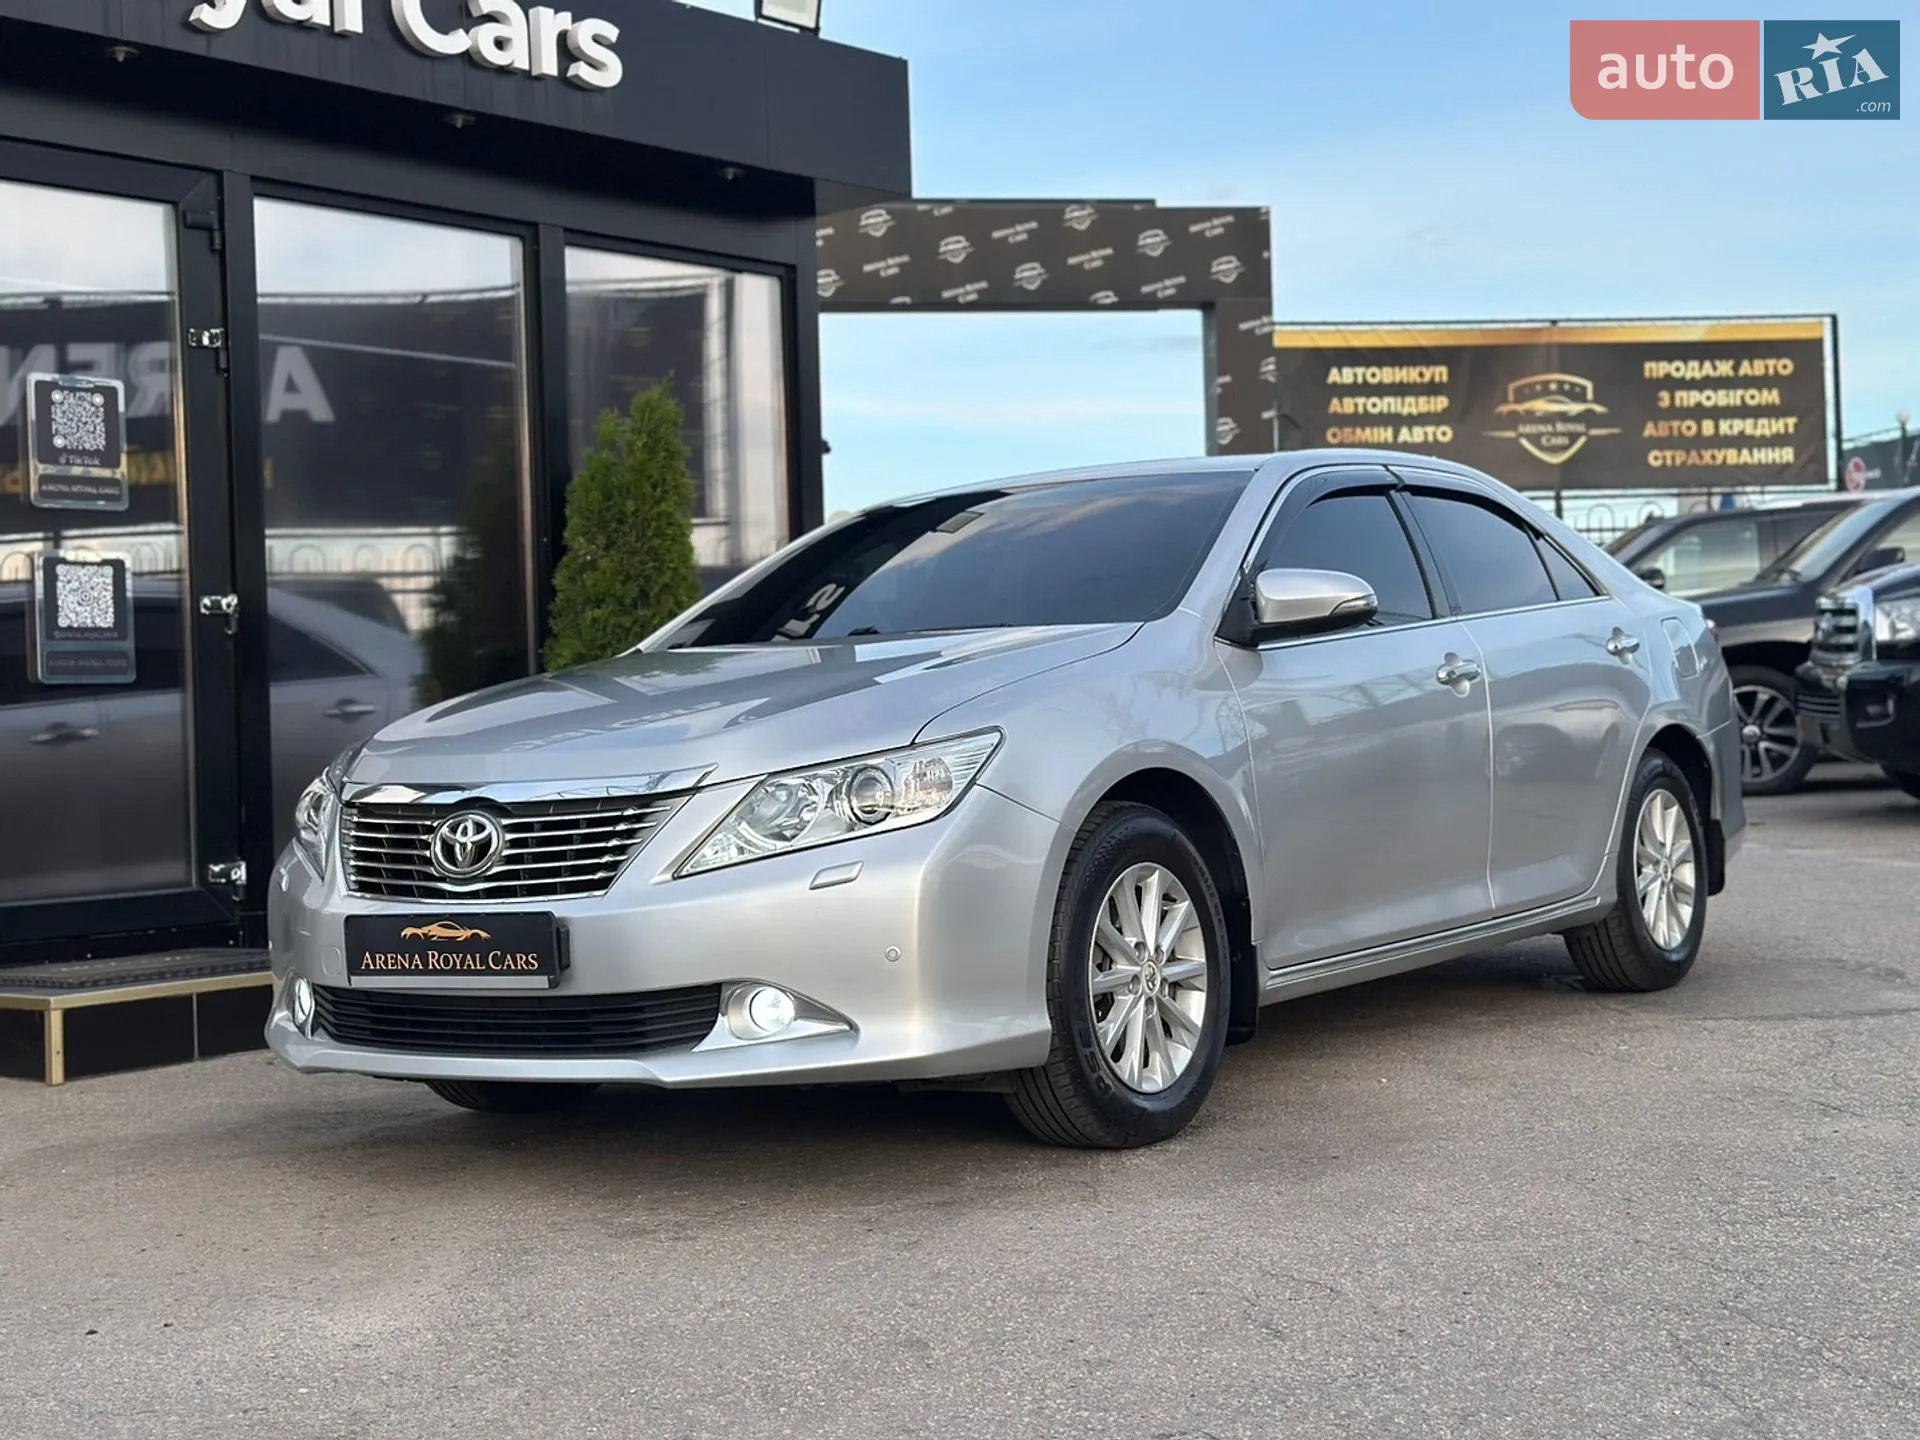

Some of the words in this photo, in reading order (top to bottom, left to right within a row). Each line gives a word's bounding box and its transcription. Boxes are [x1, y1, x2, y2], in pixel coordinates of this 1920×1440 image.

[1326, 365, 1449, 385] АВТОВИКУП
[1643, 359, 1735, 380] ПРОДАЖ
[1738, 358, 1795, 376] АВТО
[1328, 395, 1450, 416] АВТОПІДБІР
[1674, 387, 1781, 407] ПРОБІГОМ
[1326, 426, 1394, 444] ОБМІН
[1397, 425, 1454, 443] АВТО
[1642, 419, 1697, 437] АВТО
[1718, 416, 1798, 437] КРЕДИТ
[1647, 447, 1795, 467] СТРАХУВАННЯ
[361, 951, 424, 970] ARENA
[427, 950, 486, 970] ROYAL
[488, 950, 539, 970] CARS
